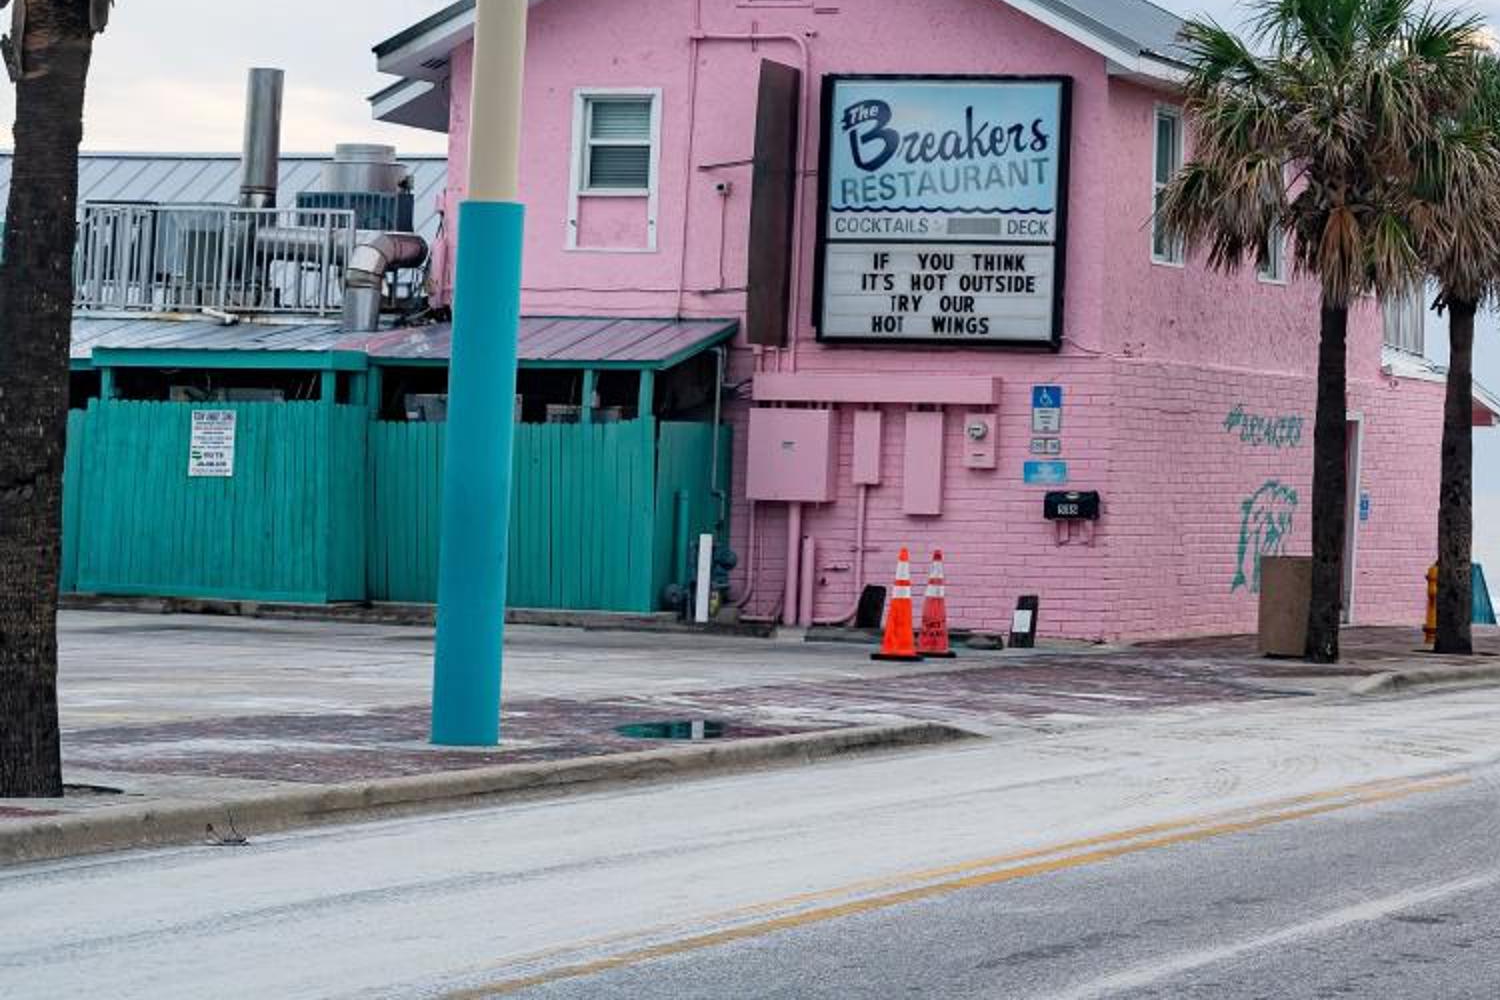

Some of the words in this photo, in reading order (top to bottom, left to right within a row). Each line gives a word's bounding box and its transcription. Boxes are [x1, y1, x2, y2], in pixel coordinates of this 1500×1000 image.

[849, 105, 879, 124] The
[842, 100, 1050, 173] Breakers
[841, 157, 1050, 205] RESTAURANT
[834, 217, 929, 234] COCKTAILS
[1007, 219, 1049, 236] DECK
[873, 253, 890, 271] IF
[918, 253, 955, 271] YOU
[972, 253, 1026, 272] THINK
[861, 273, 895, 291] IT'S
[910, 274, 948, 291] HOT
[958, 275, 1036, 293] OUTSIDE
[890, 295, 923, 313] TRY
[939, 296, 975, 313] OUR
[871, 315, 904, 333] HOT
[932, 316, 990, 335] WINGS
